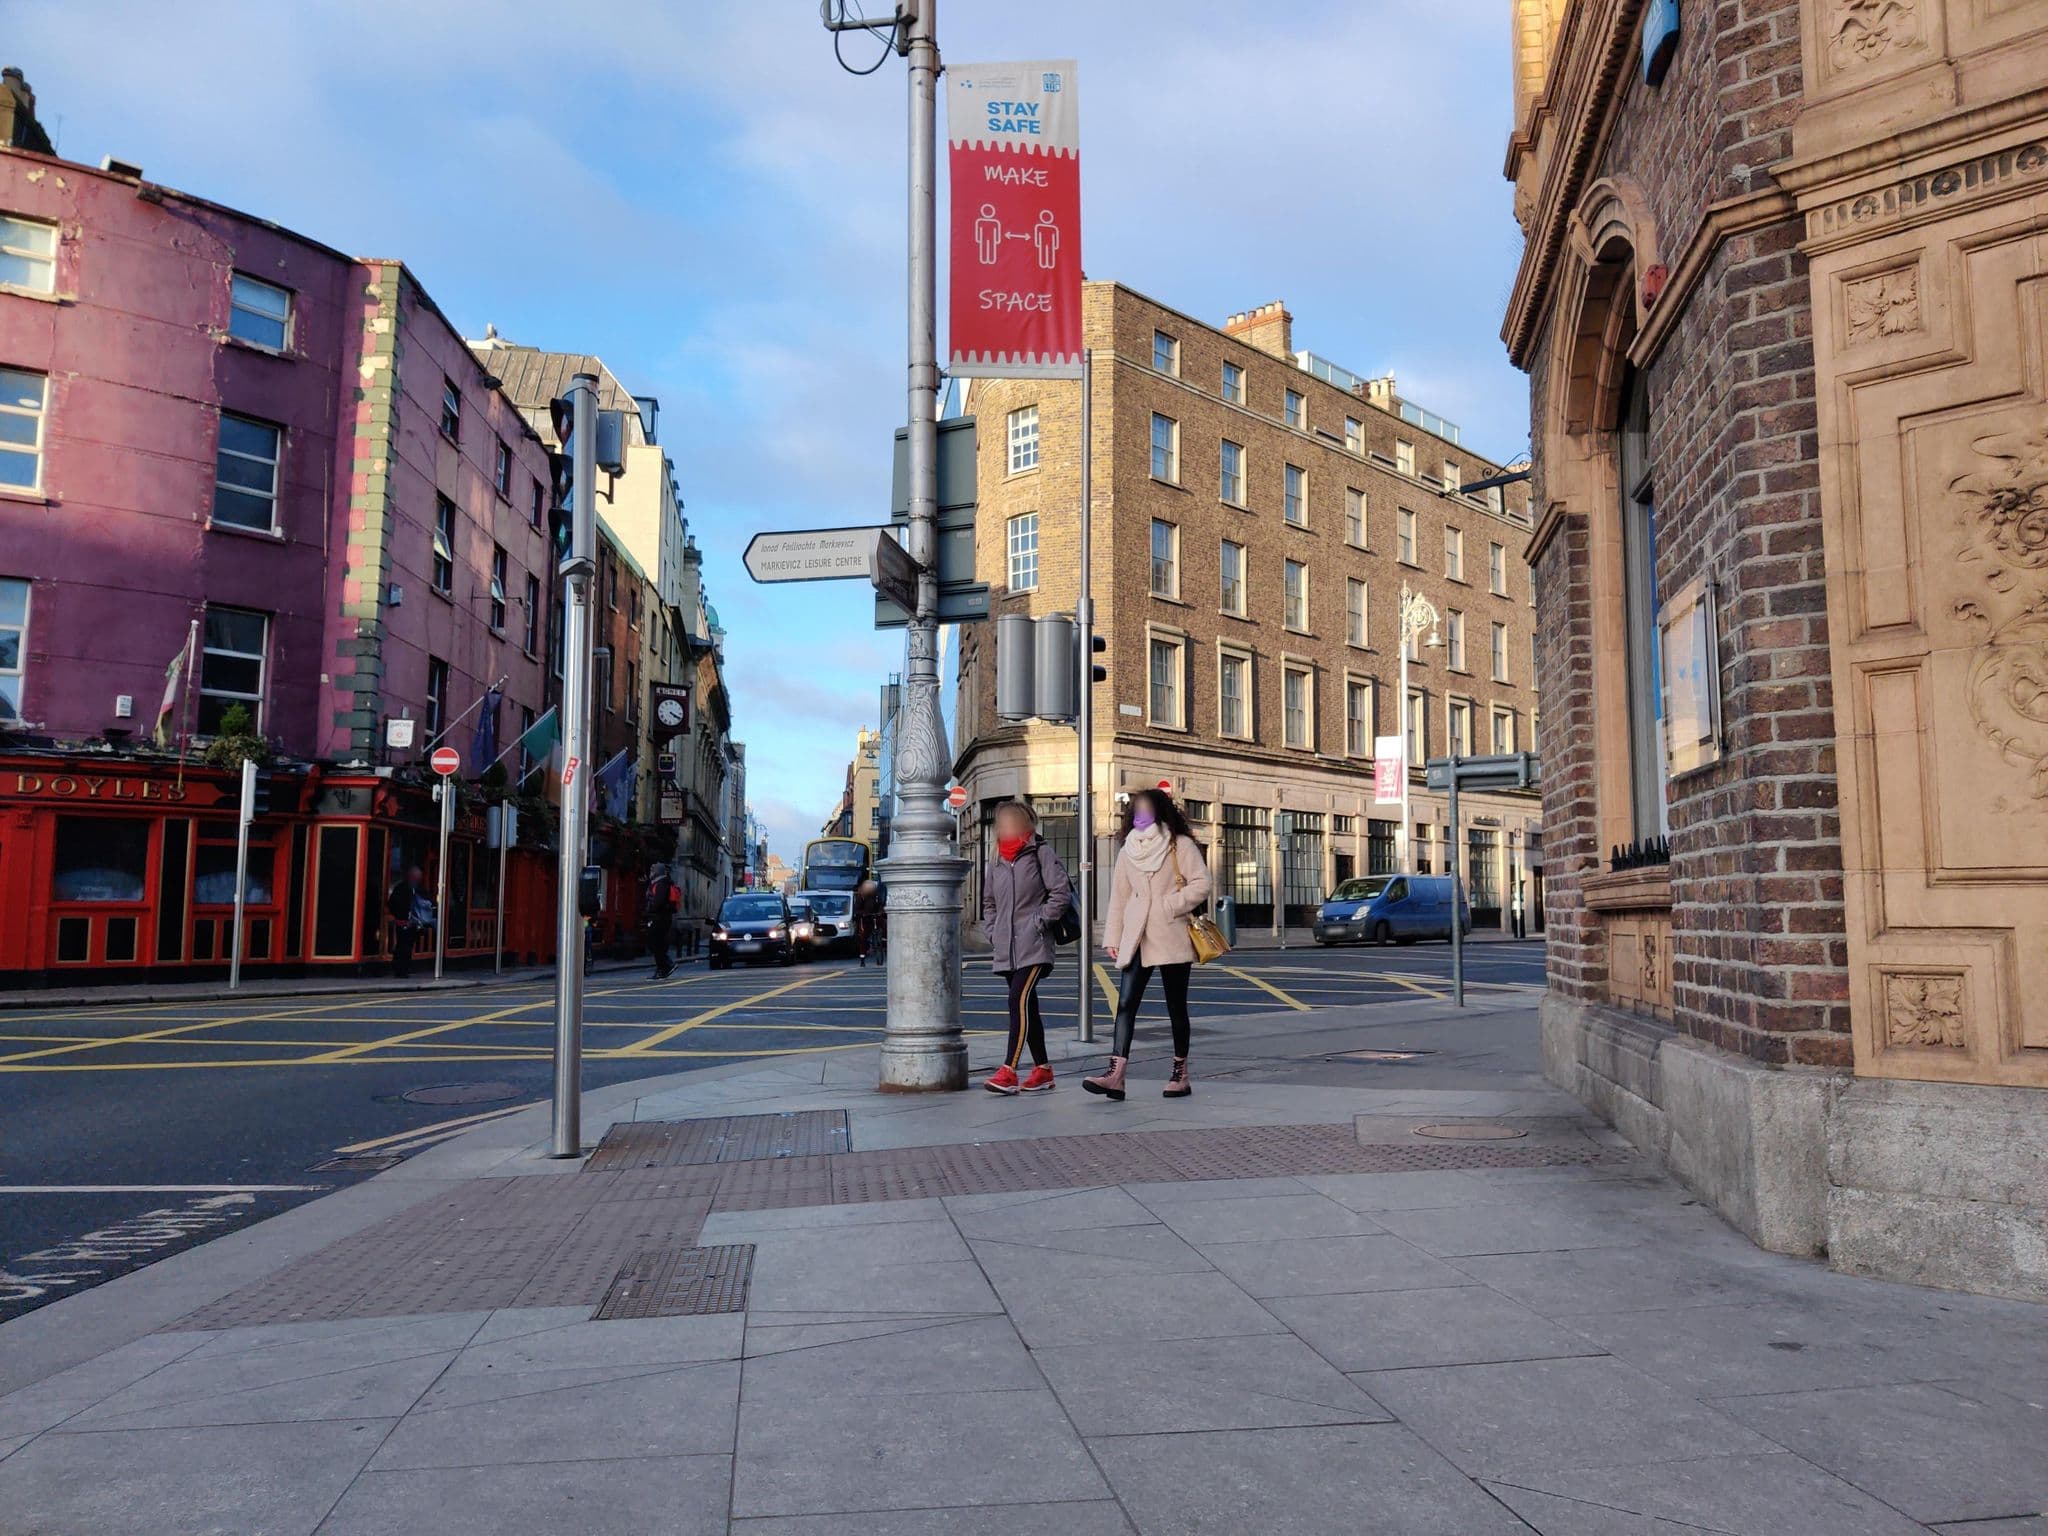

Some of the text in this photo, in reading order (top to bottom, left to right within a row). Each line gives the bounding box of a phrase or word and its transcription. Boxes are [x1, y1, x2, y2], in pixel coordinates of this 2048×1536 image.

[987, 101, 1040, 117] STAY
[988, 117, 1041, 135] SAFE
[984, 164, 1049, 188] MAKE
[978, 289, 1052, 313] SPACE
[760, 556, 862, 571] MARKIEVICZ LEISURE CENTRE
[16, 774, 187, 801] DOYLES
